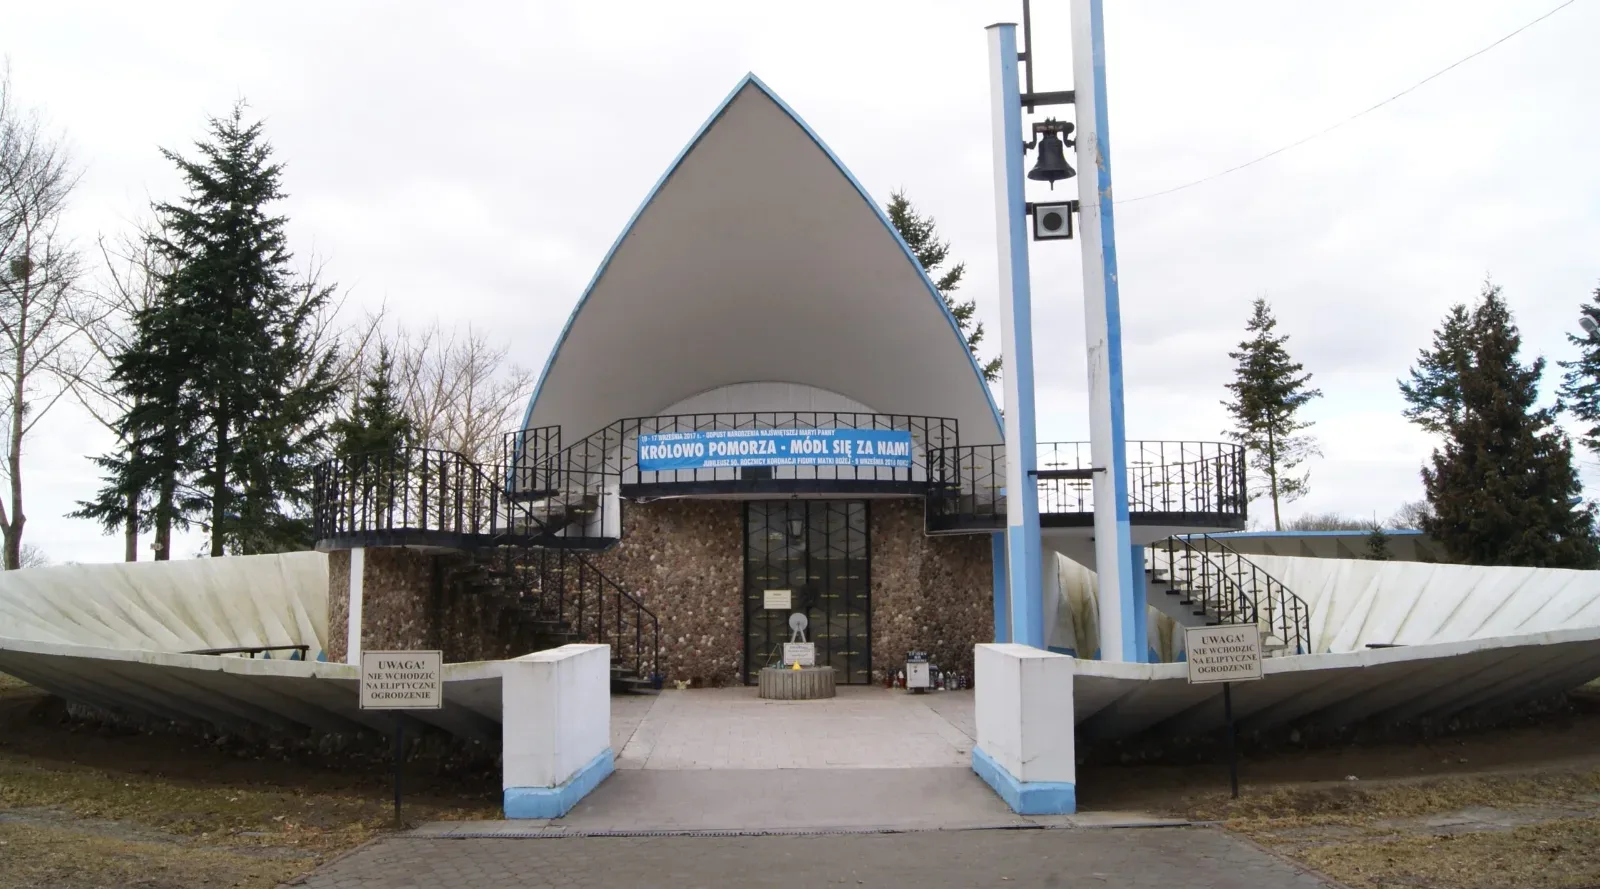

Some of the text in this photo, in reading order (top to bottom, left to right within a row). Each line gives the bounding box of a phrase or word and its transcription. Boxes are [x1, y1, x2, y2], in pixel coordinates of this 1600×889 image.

[658, 432, 683, 441] WRZEŚNIA
[684, 431, 697, 440] 2017
[705, 430, 727, 439] ODPUST
[727, 429, 760, 438] NARODZENIA
[760, 428, 798, 437] NAJŚWIĘTSZEJ
[799, 428, 817, 436] MARYI
[817, 428, 836, 436] PANNY
[641, 440, 704, 460] KRÓLOWO
[709, 440, 777, 456] POMORZA
[790, 436, 829, 454] MÓDL
[832, 439, 852, 458] SIĘ
[856, 440, 874, 455] ZA
[877, 441, 909, 456] NAMI
[703, 459, 730, 467] JUBILEUSZ
[740, 458, 767, 466] ROCZNICY
[767, 457, 796, 465] KORONACJI
[797, 456, 817, 465] FIGURY
[817, 457, 835, 465] MATKI
[859, 457, 884, 466] WRZEŚNIA
[1201, 634, 1245, 645] UWAGA!
[1193, 644, 1255, 655] NIE WCHODZIĆ
[1205, 654, 1258, 664] ELIPTYCZNE
[378, 660, 425, 670] UWAGA!
[1198, 663, 1254, 674] OGRODZENIE
[385, 671, 436, 680] WCHODZIĆ
[371, 691, 431, 699] OGRODZENIE
